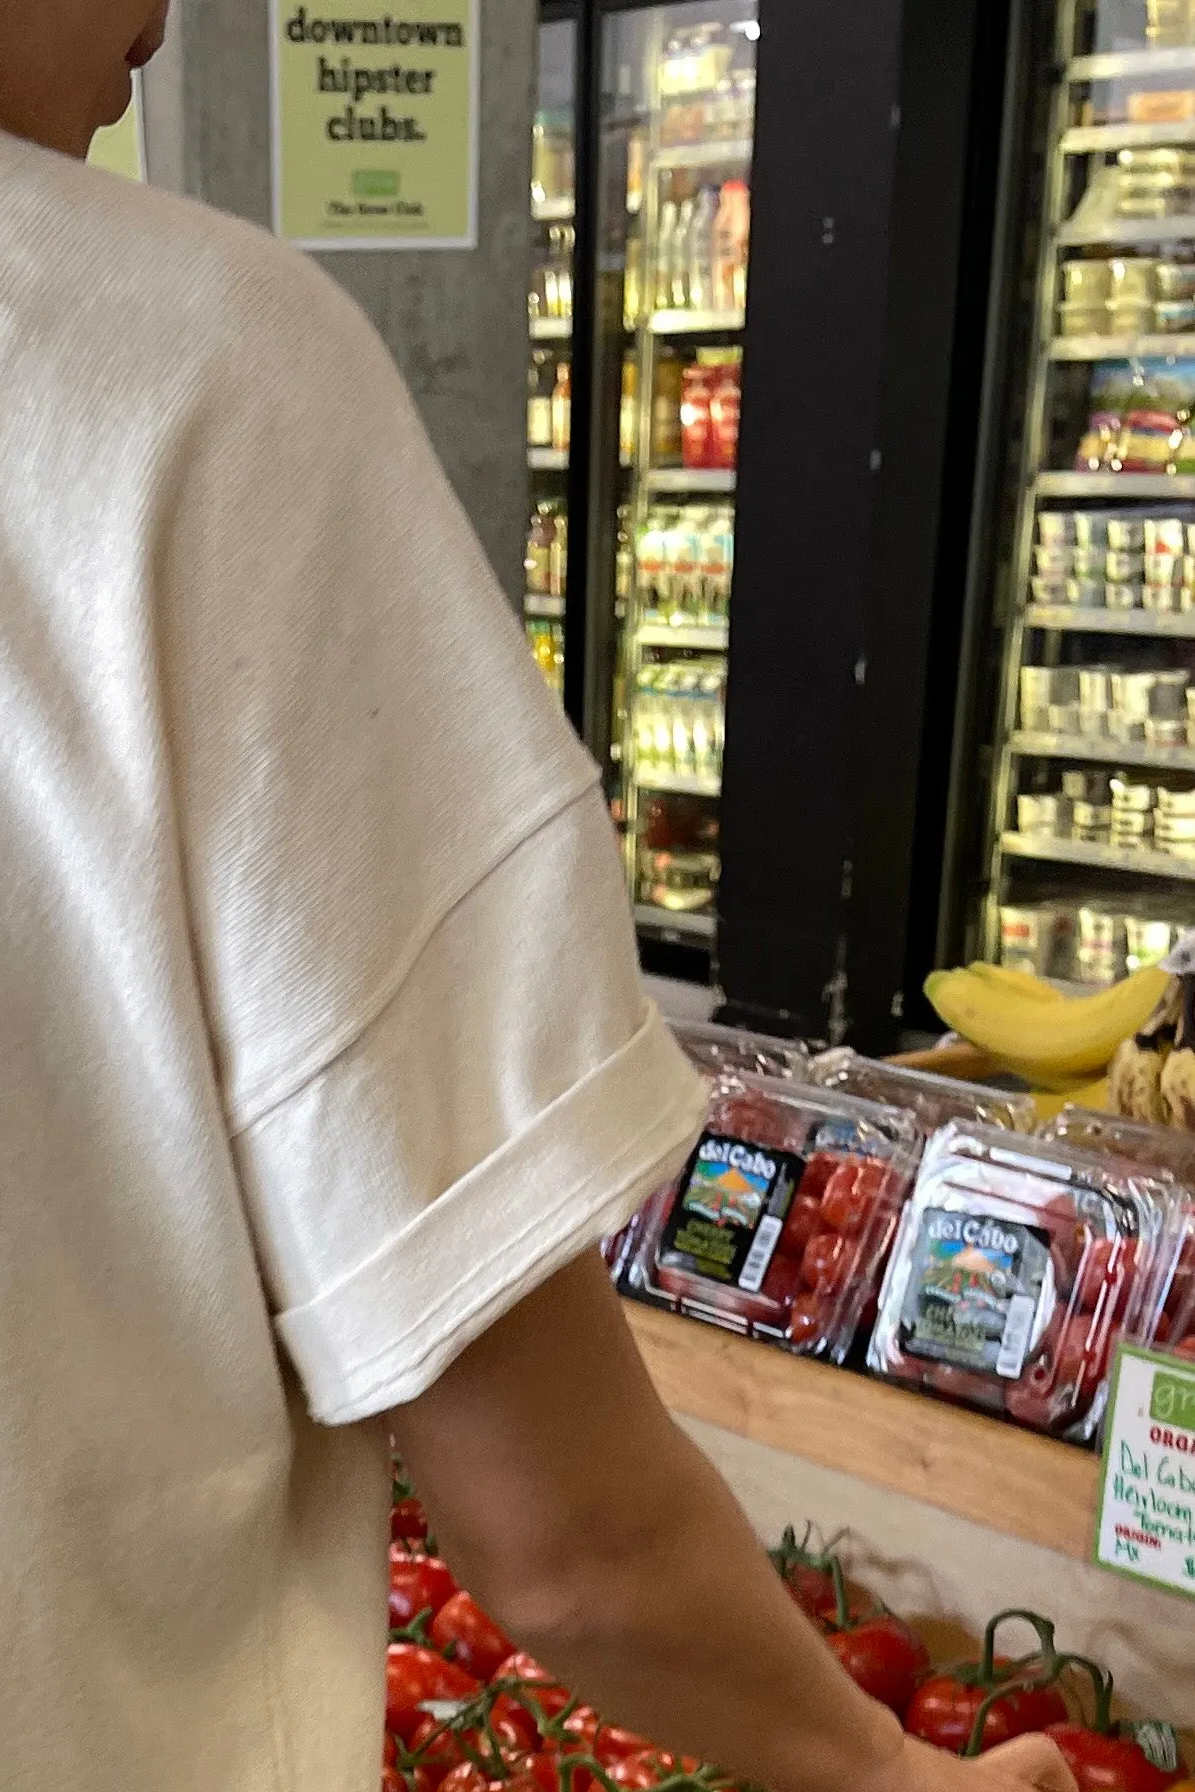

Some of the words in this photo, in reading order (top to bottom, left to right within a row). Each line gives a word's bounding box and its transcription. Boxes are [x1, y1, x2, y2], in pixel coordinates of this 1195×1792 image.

[287, 6, 464, 47] downtown
[318, 56, 434, 101] hipster
[928, 1218, 963, 1240] del
[1121, 1440, 1148, 1480] Del
[1113, 1473, 1192, 1521] Heirloom
[1133, 1508, 1195, 1546] Tomat
